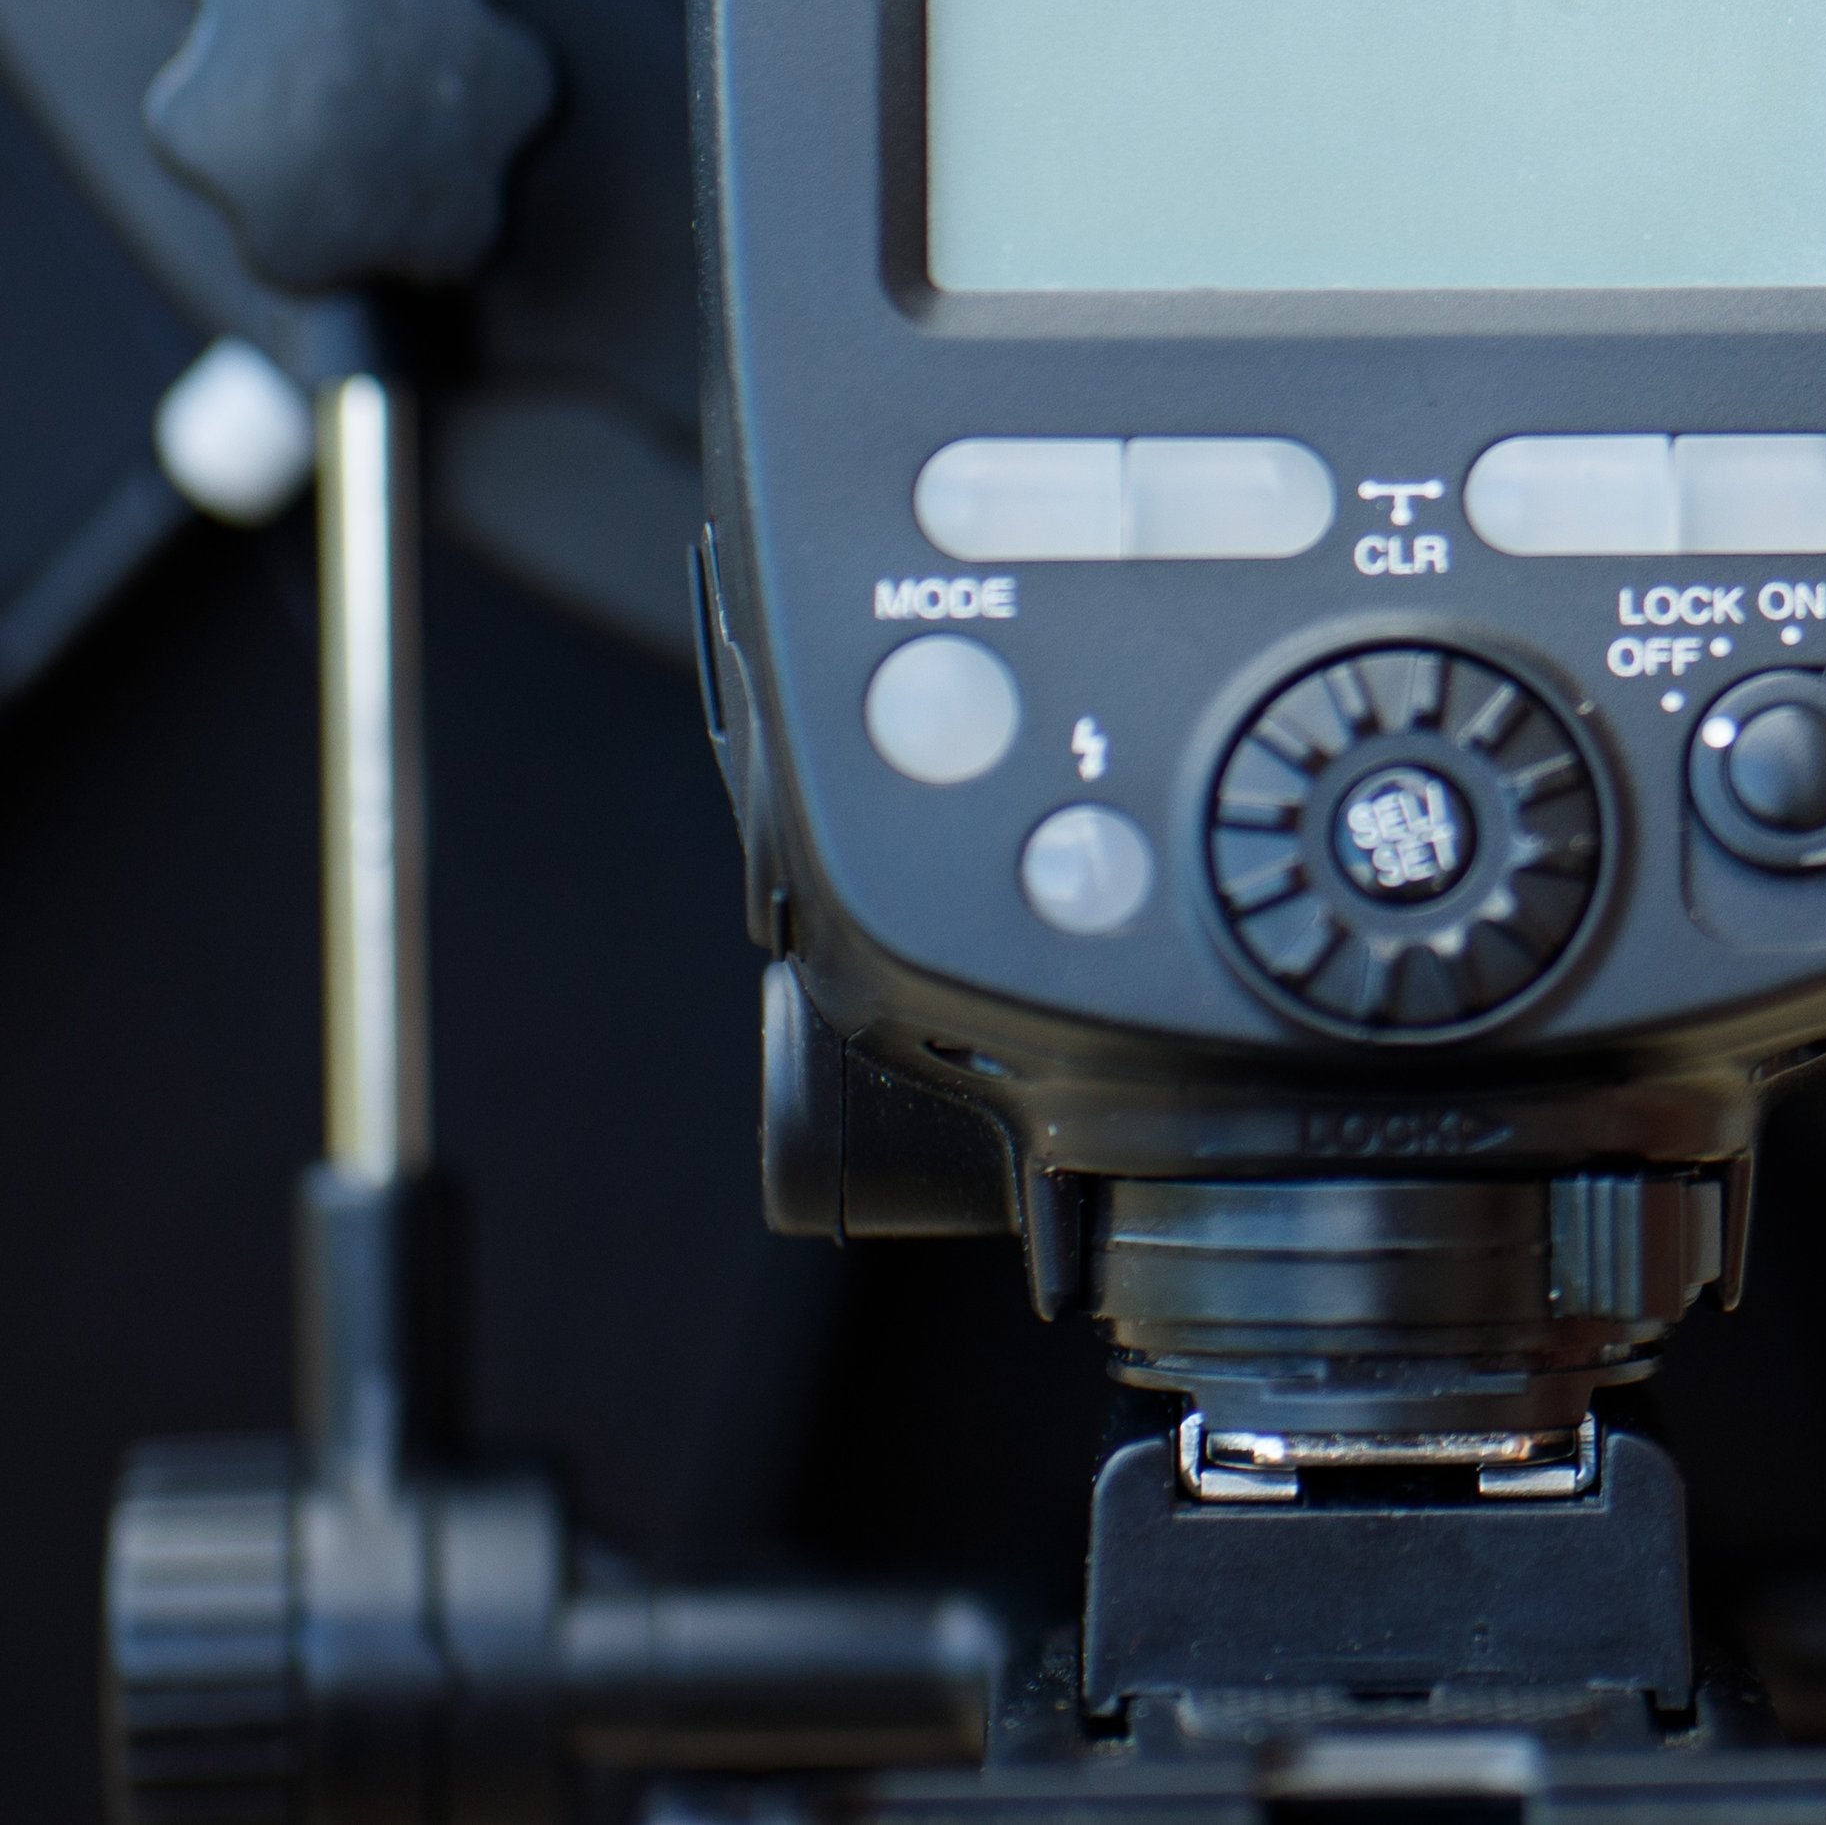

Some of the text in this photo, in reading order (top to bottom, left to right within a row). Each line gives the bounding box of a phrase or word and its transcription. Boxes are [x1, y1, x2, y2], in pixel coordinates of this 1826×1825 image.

[1353, 534, 1448, 576] CLR
[874, 577, 1018, 620] MODE
[1618, 584, 1748, 626] LOCK
[1606, 636, 1704, 678] OFF
[1371, 822, 1457, 888] SET
